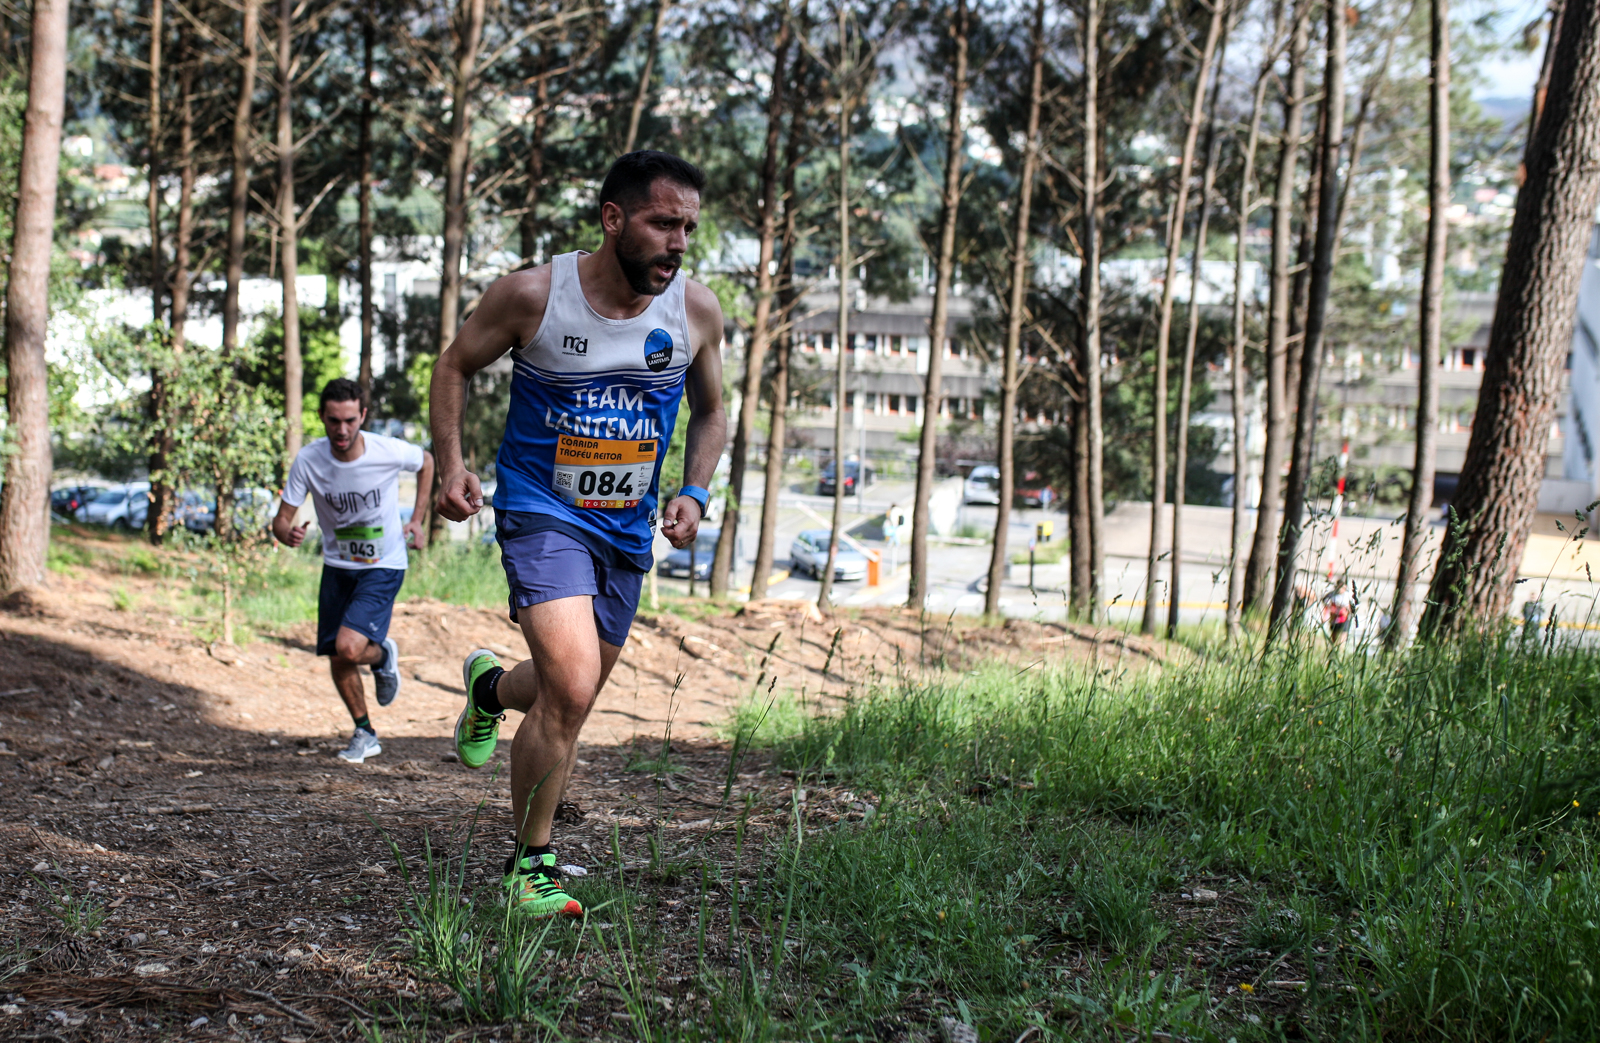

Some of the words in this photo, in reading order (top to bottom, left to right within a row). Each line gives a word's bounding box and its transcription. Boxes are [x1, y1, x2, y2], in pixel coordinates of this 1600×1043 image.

[572, 386, 645, 411] TEAM
[545, 406, 660, 440] LANTEMIL
[561, 437, 599, 449] CORRIDA
[559, 448, 592, 459] TROFÉU
[593, 452, 622, 460] REITOR
[578, 470, 634, 496] 084
[349, 541, 375, 557] 043
